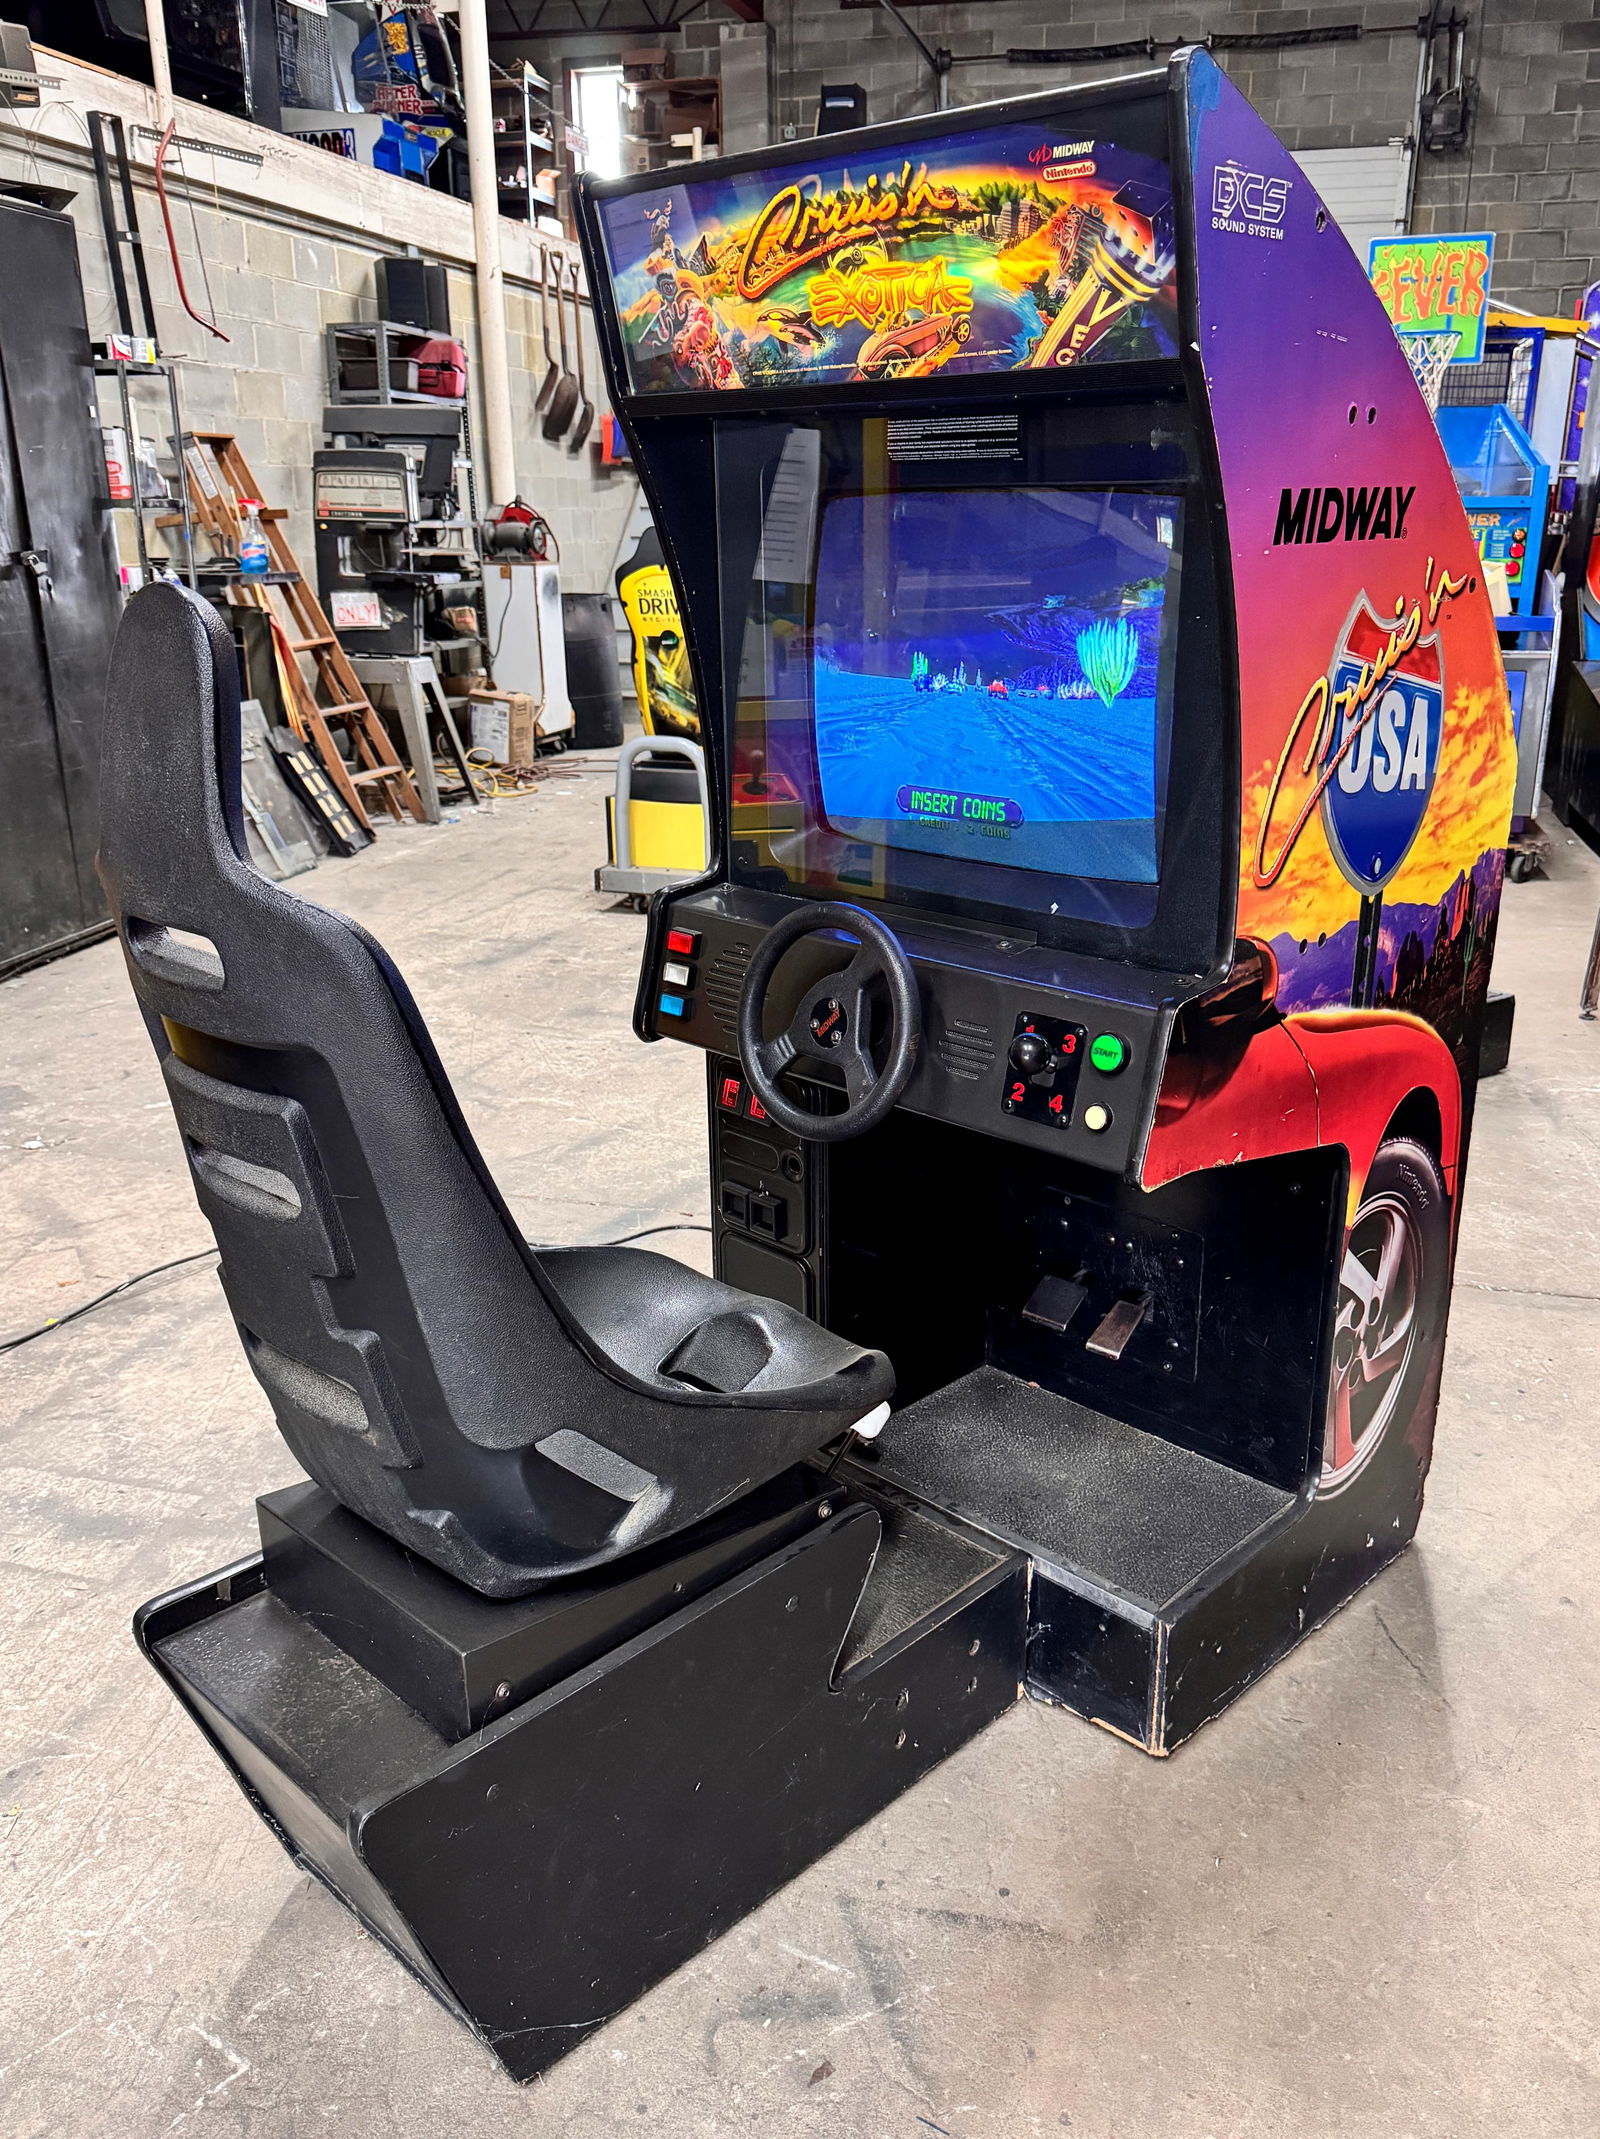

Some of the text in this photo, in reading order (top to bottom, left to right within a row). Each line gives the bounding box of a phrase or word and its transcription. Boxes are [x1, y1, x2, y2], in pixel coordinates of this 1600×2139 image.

[377, 85, 417, 99] AFTER
[1052, 140, 1095, 159] MIDWAY
[1045, 163, 1093, 179] Nintendo
[1212, 165, 1287, 224] DCS
[738, 160, 957, 299] Cruis'n
[1211, 216, 1284, 241] SOUND SYSTEM
[808, 257, 973, 328] EXOTICA
[1273, 485, 1417, 547] MIDWAY
[336, 603, 379, 622] ONLY!
[1253, 556, 1468, 889] Cruis'n
[1337, 677, 1429, 795] USA
[911, 790, 1006, 822] INSERT COINS
[1062, 1034, 1119, 1060] 3 START
[1011, 1082, 1063, 1113] 2 4
